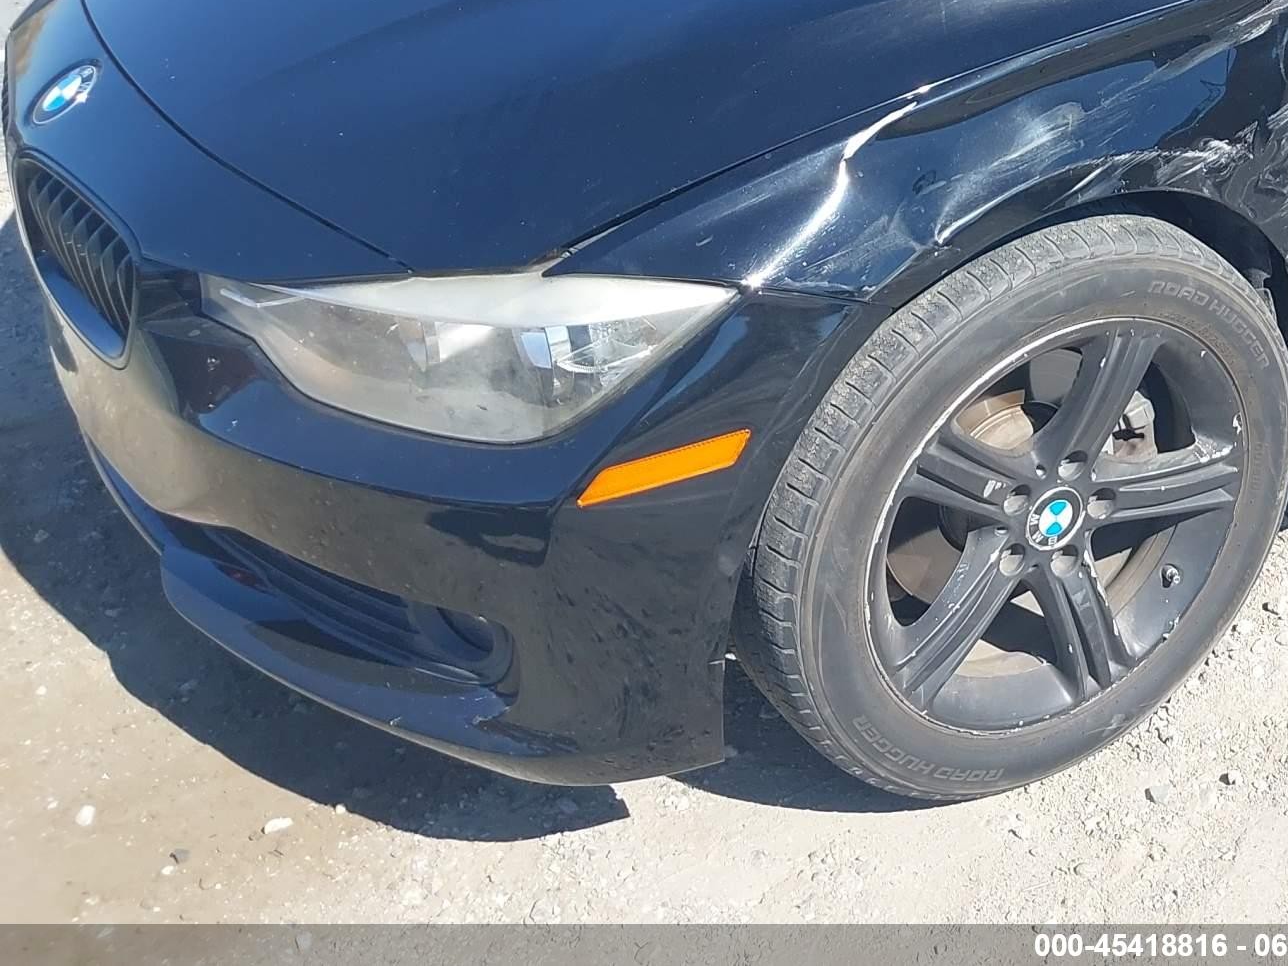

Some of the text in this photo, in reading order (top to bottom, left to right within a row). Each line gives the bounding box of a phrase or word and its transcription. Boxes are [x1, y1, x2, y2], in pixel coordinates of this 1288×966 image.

[1148, 280, 1211, 307] ROAD
[1208, 298, 1270, 369] HUGGER
[852, 714, 1005, 782] ROAD HUGGER
